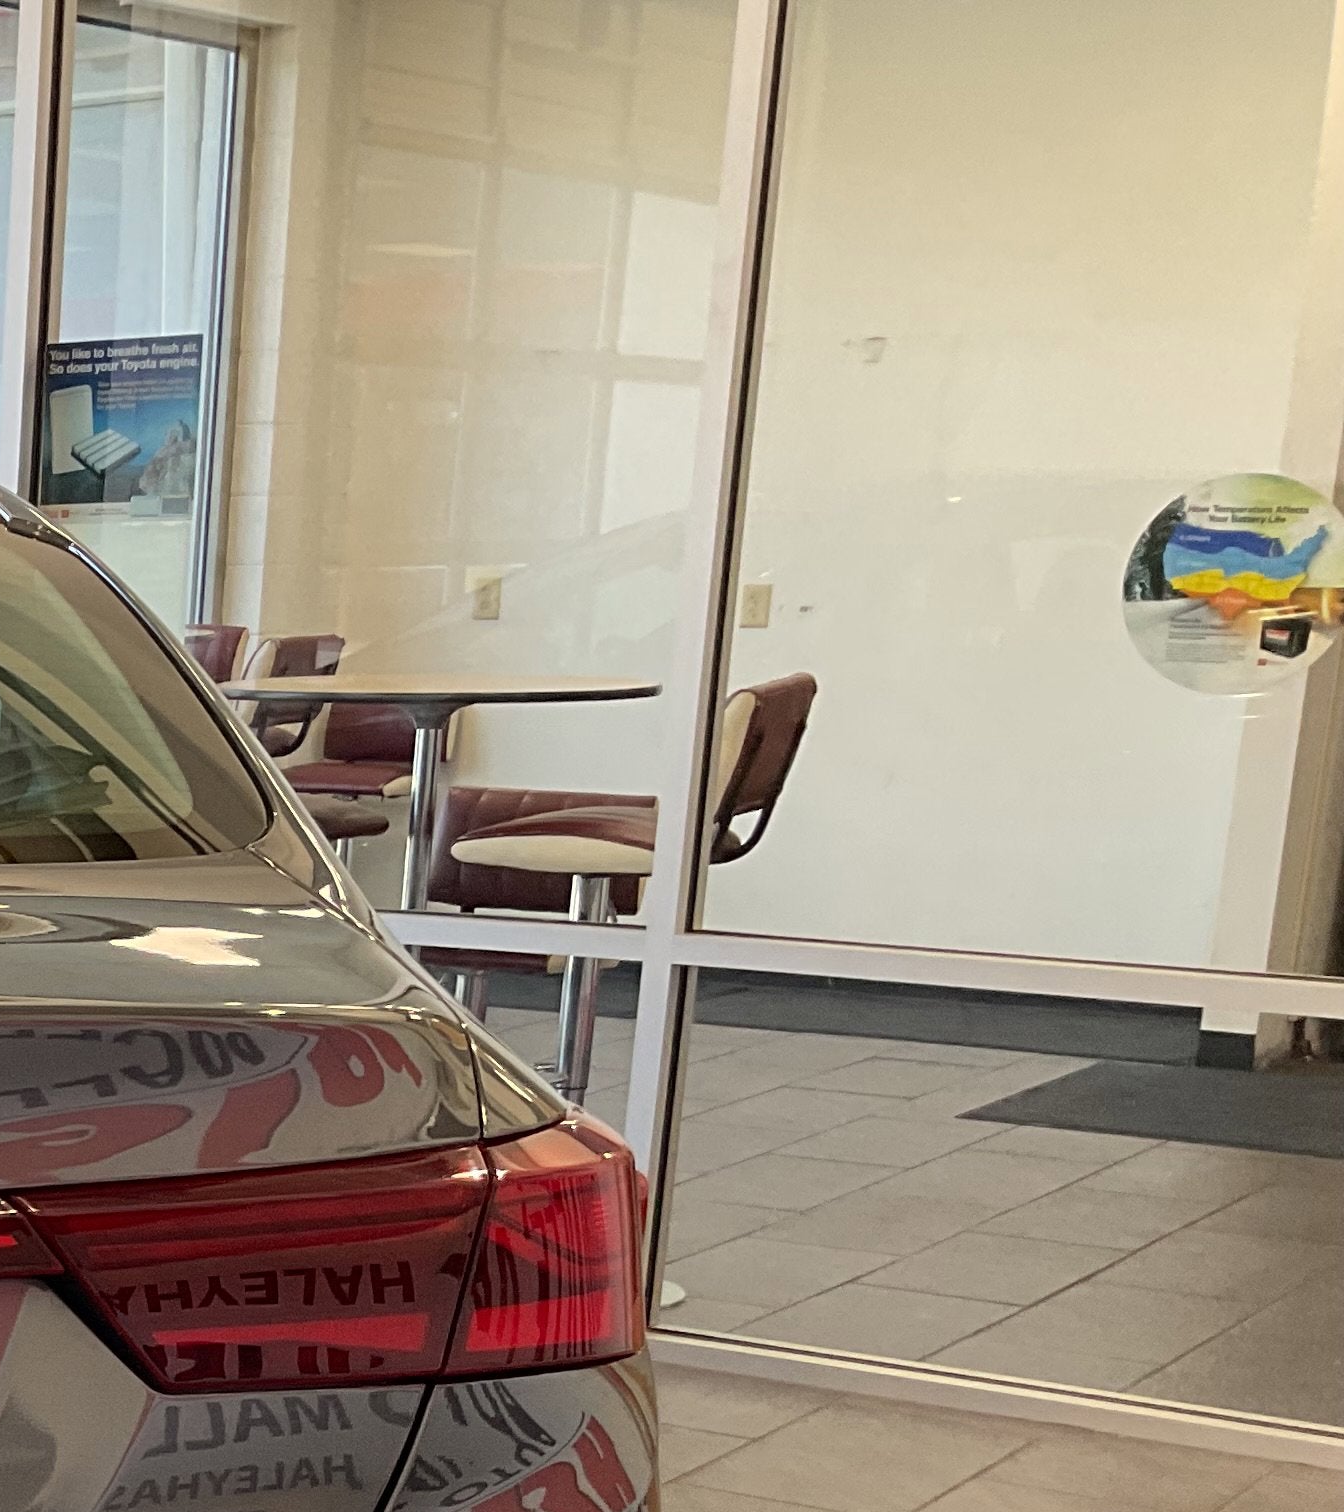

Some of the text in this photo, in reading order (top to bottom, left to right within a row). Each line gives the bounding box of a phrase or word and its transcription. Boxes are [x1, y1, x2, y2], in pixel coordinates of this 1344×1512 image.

[50, 350, 69, 361] You
[72, 348, 91, 359] like
[94, 348, 104, 358] to
[107, 345, 148, 357] breathe
[152, 343, 179, 355] fresh
[49, 364, 64, 375] So
[67, 362, 92, 374] does
[95, 361, 119, 374] your
[122, 358, 156, 372] Toyota
